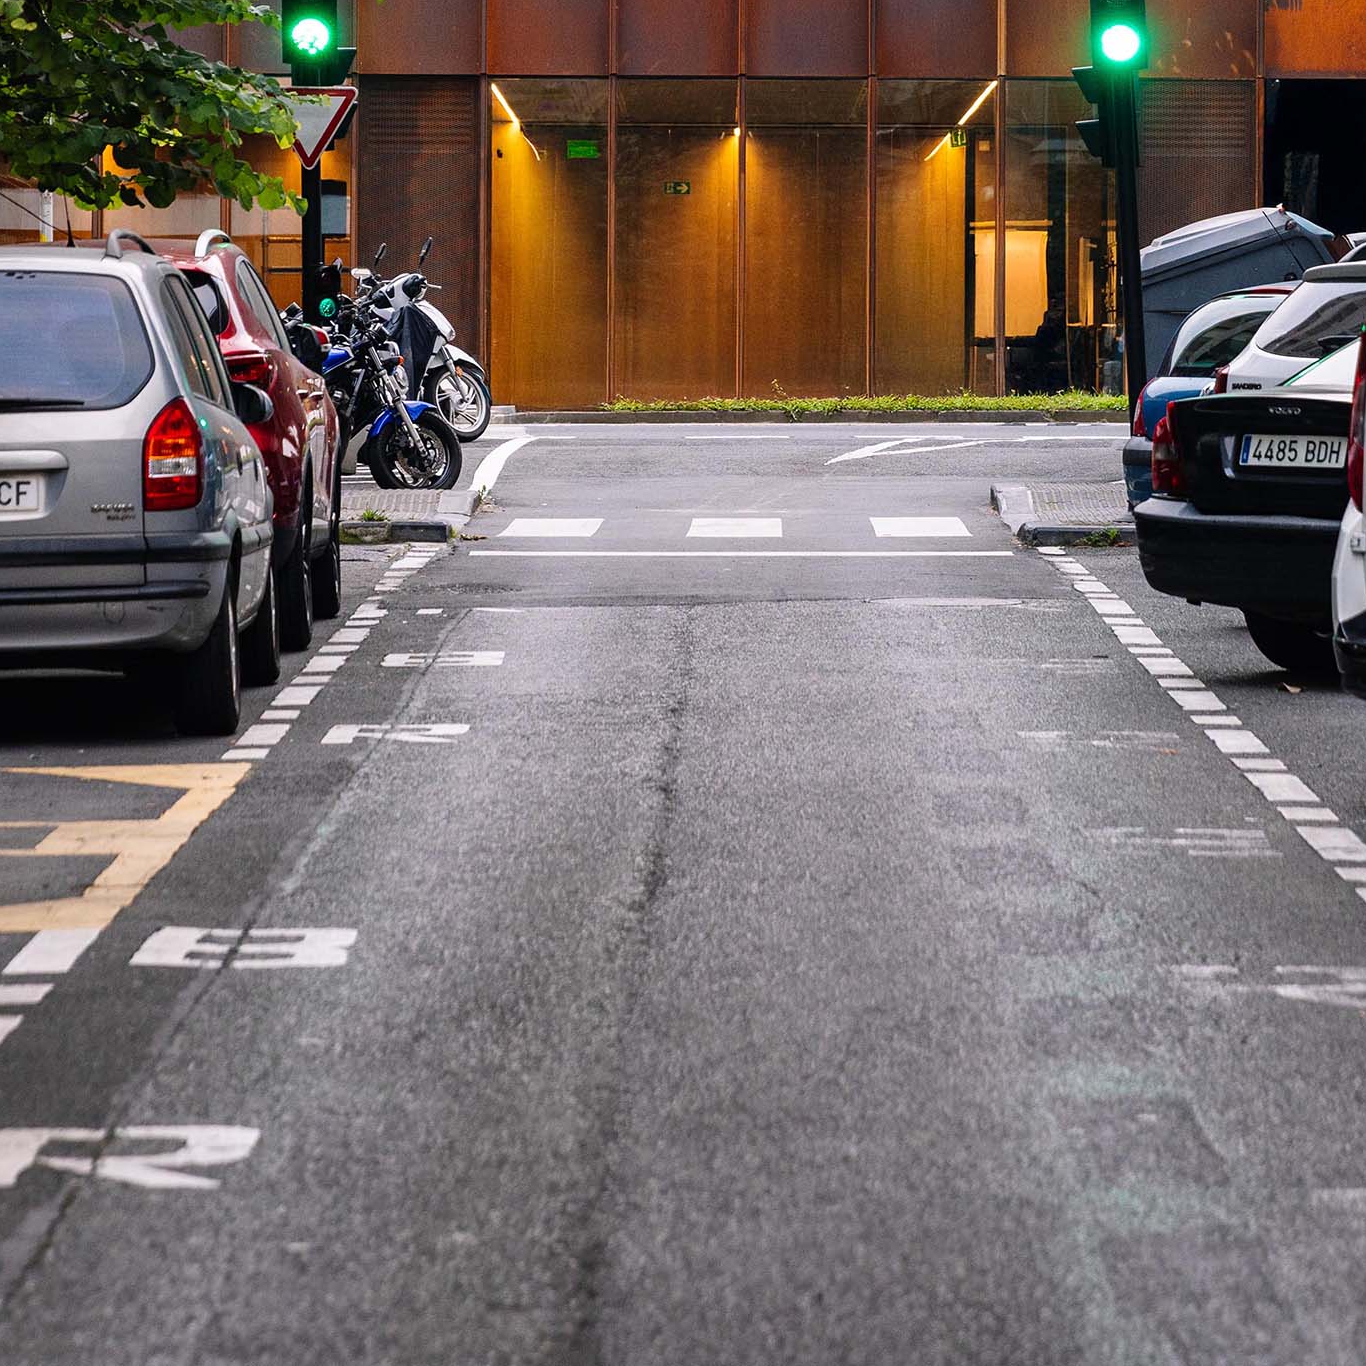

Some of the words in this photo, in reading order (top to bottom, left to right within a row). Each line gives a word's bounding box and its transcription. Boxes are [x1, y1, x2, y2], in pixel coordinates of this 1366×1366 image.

[1268, 406, 1301, 415] VOLVO
[1252, 438, 1298, 462] 4485
[1304, 440, 1342, 464] BDH
[320, 724, 471, 744] R
[129, 926, 358, 968] B
